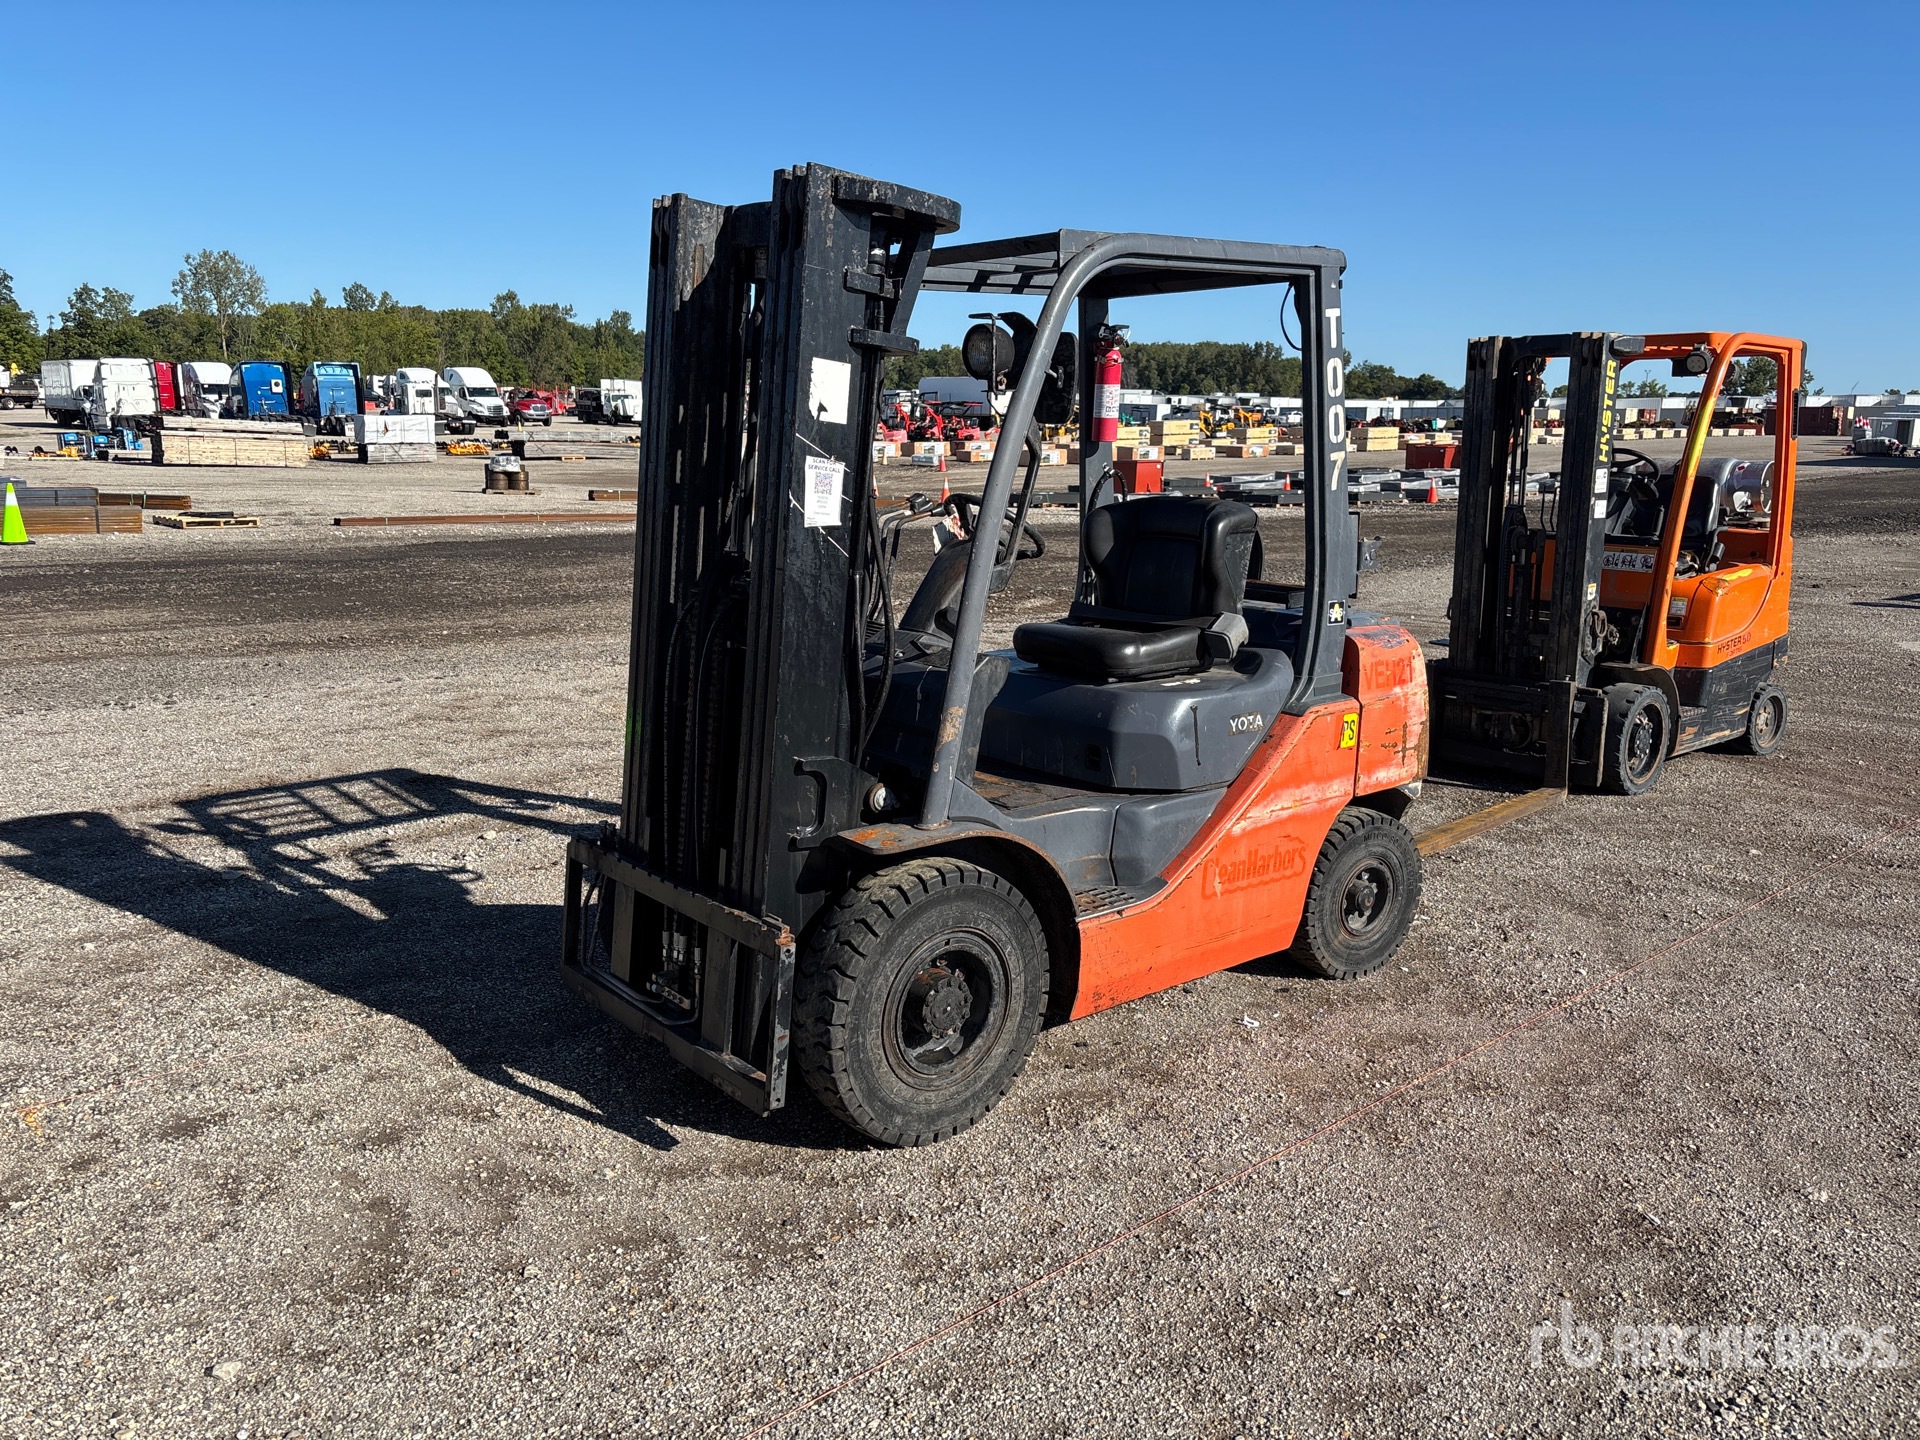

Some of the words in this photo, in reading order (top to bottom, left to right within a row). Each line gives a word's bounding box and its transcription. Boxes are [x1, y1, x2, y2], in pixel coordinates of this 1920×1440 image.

[1598, 359, 1617, 463] HYSTER
[1717, 635, 1742, 655] HYSTER
[1742, 632, 1752, 645] 50
